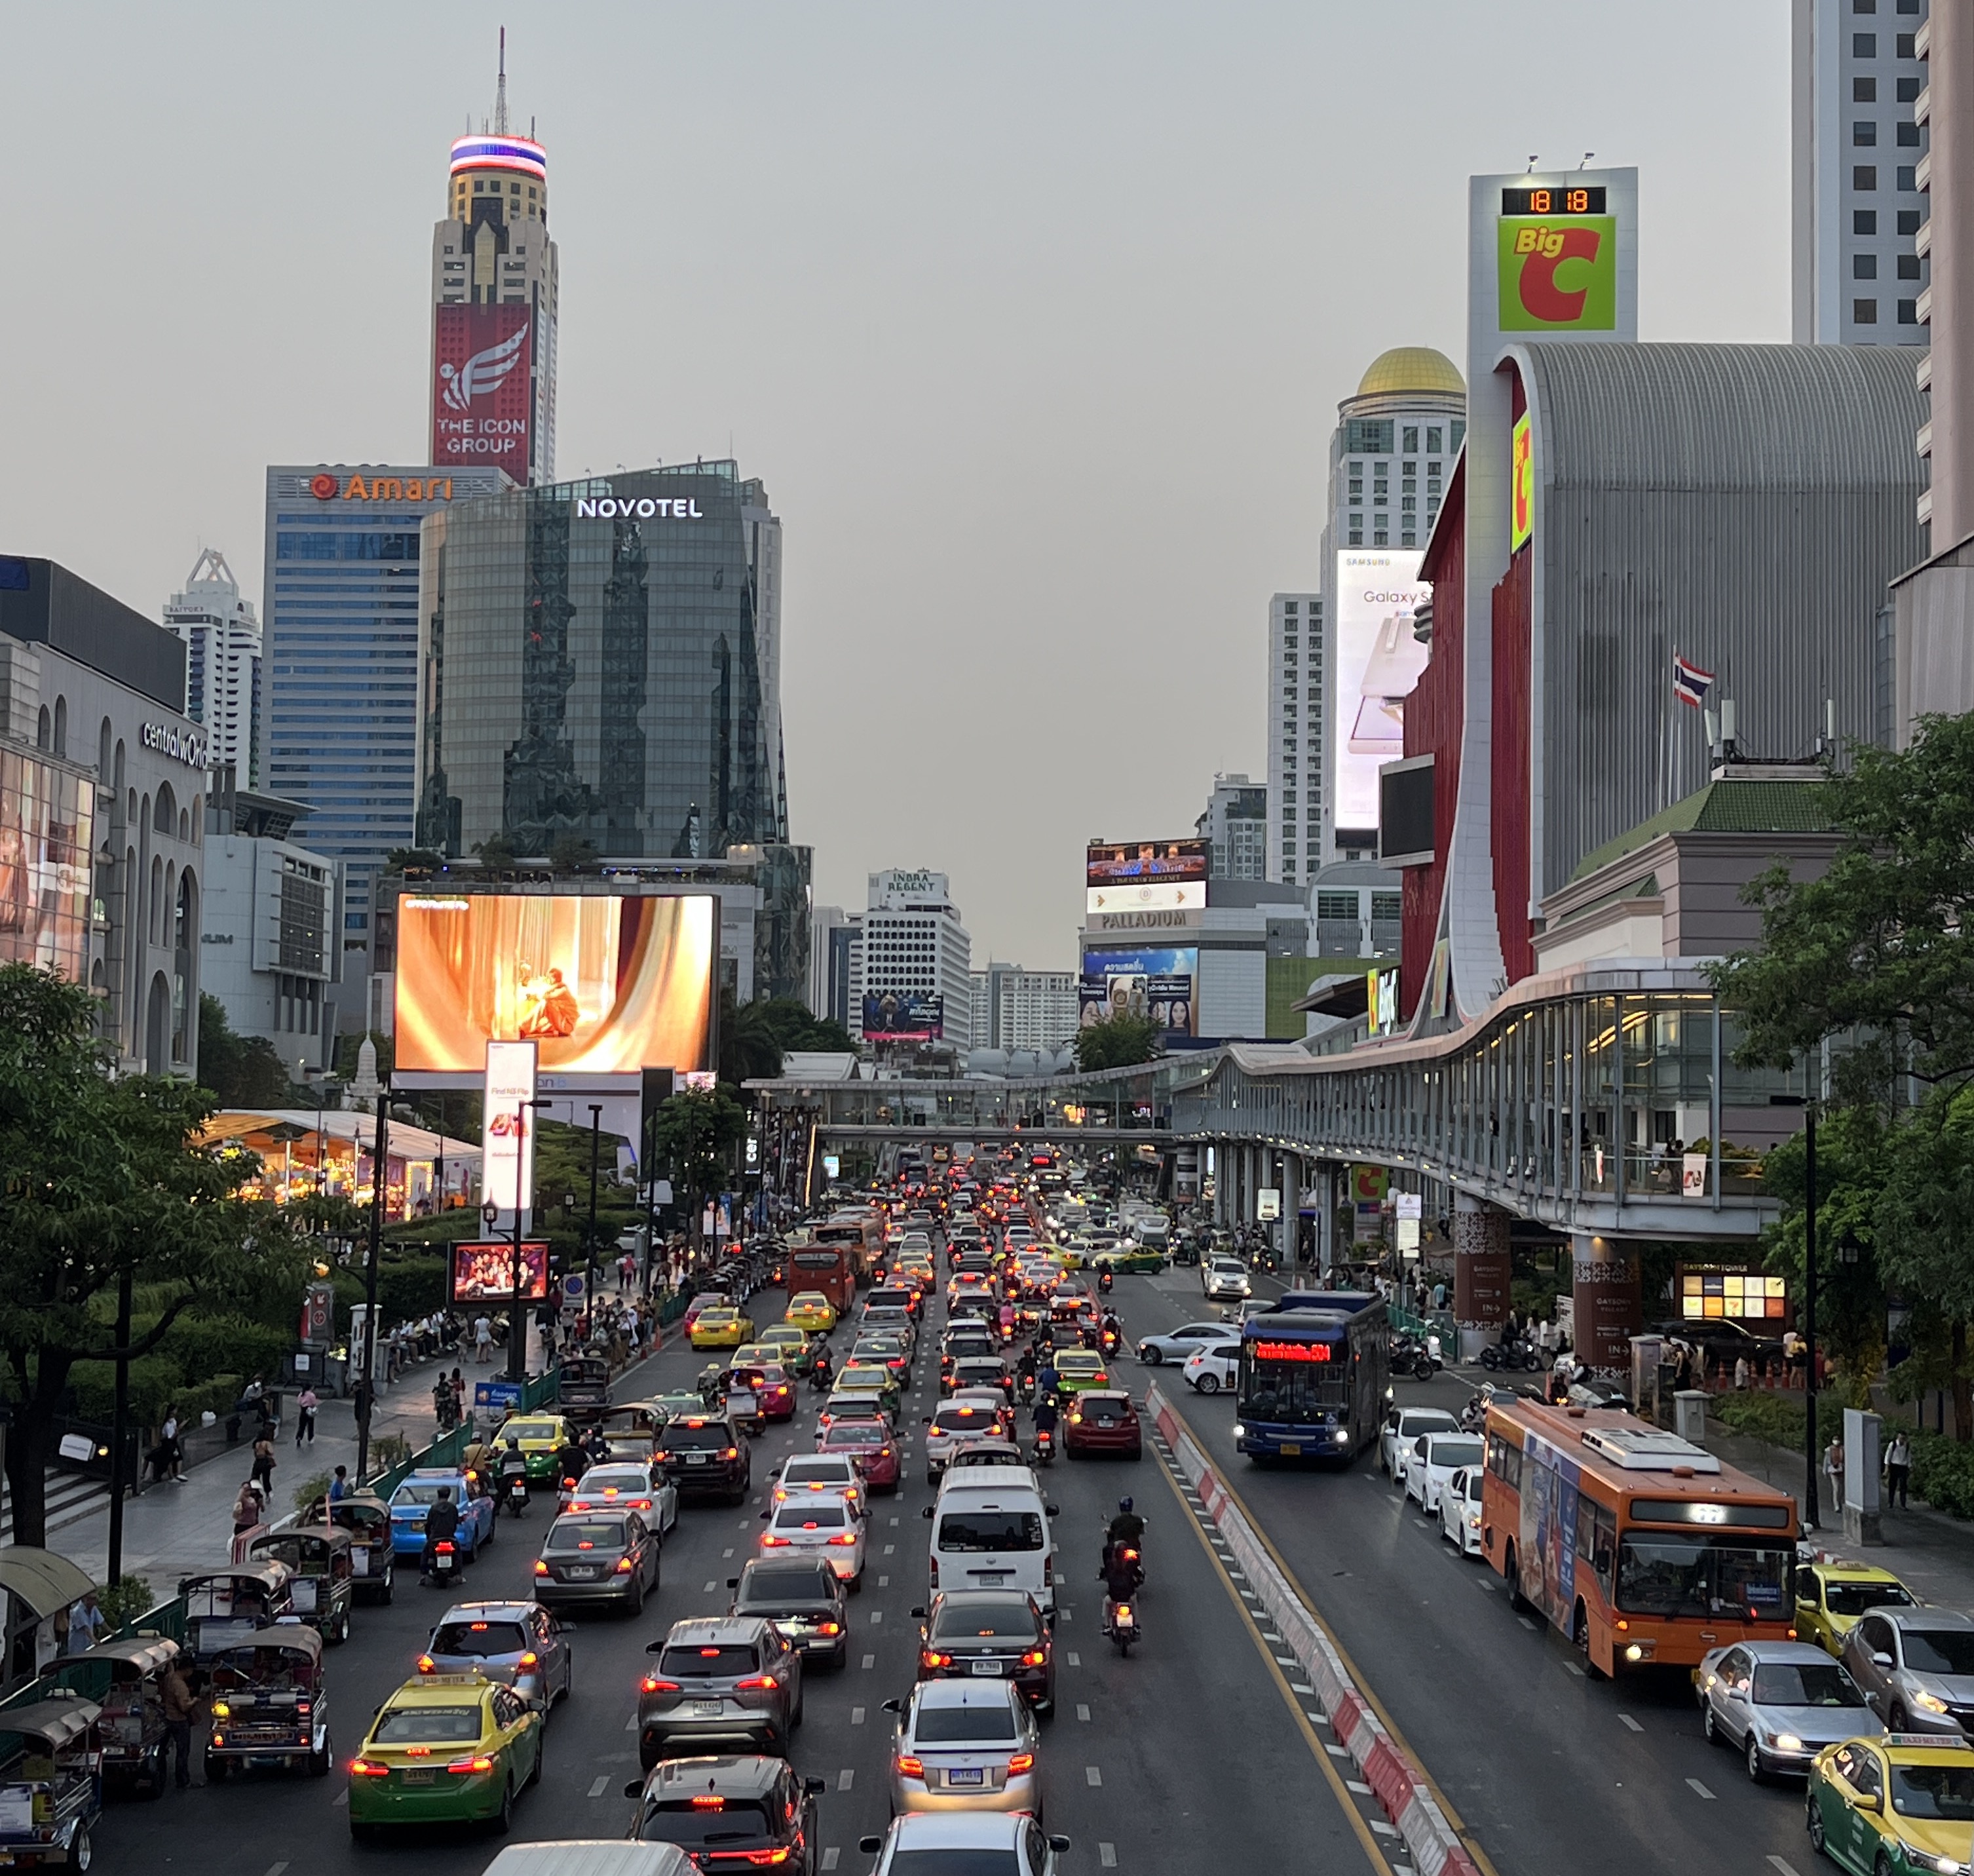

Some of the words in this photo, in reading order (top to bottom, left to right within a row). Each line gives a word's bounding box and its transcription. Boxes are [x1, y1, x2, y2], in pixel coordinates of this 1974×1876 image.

[1530, 190, 1550, 212] 18
[1567, 190, 1587, 212] 18
[1515, 226, 1565, 258] Big
[1519, 227, 1601, 322] C
[437, 419, 474, 434] THE
[447, 438, 516, 453] GROUP
[343, 472, 453, 501] Amari
[577, 497, 703, 518] NOVOTEL
[1346, 558, 1390, 566] SAMSUNG
[1364, 591, 1417, 605] Galaxy
[893, 873, 928, 882] INDRA
[888, 883, 935, 891] REGENT
[1103, 911, 1186, 929] PALLADIUM
[1608, 1345, 1622, 1354] IN
